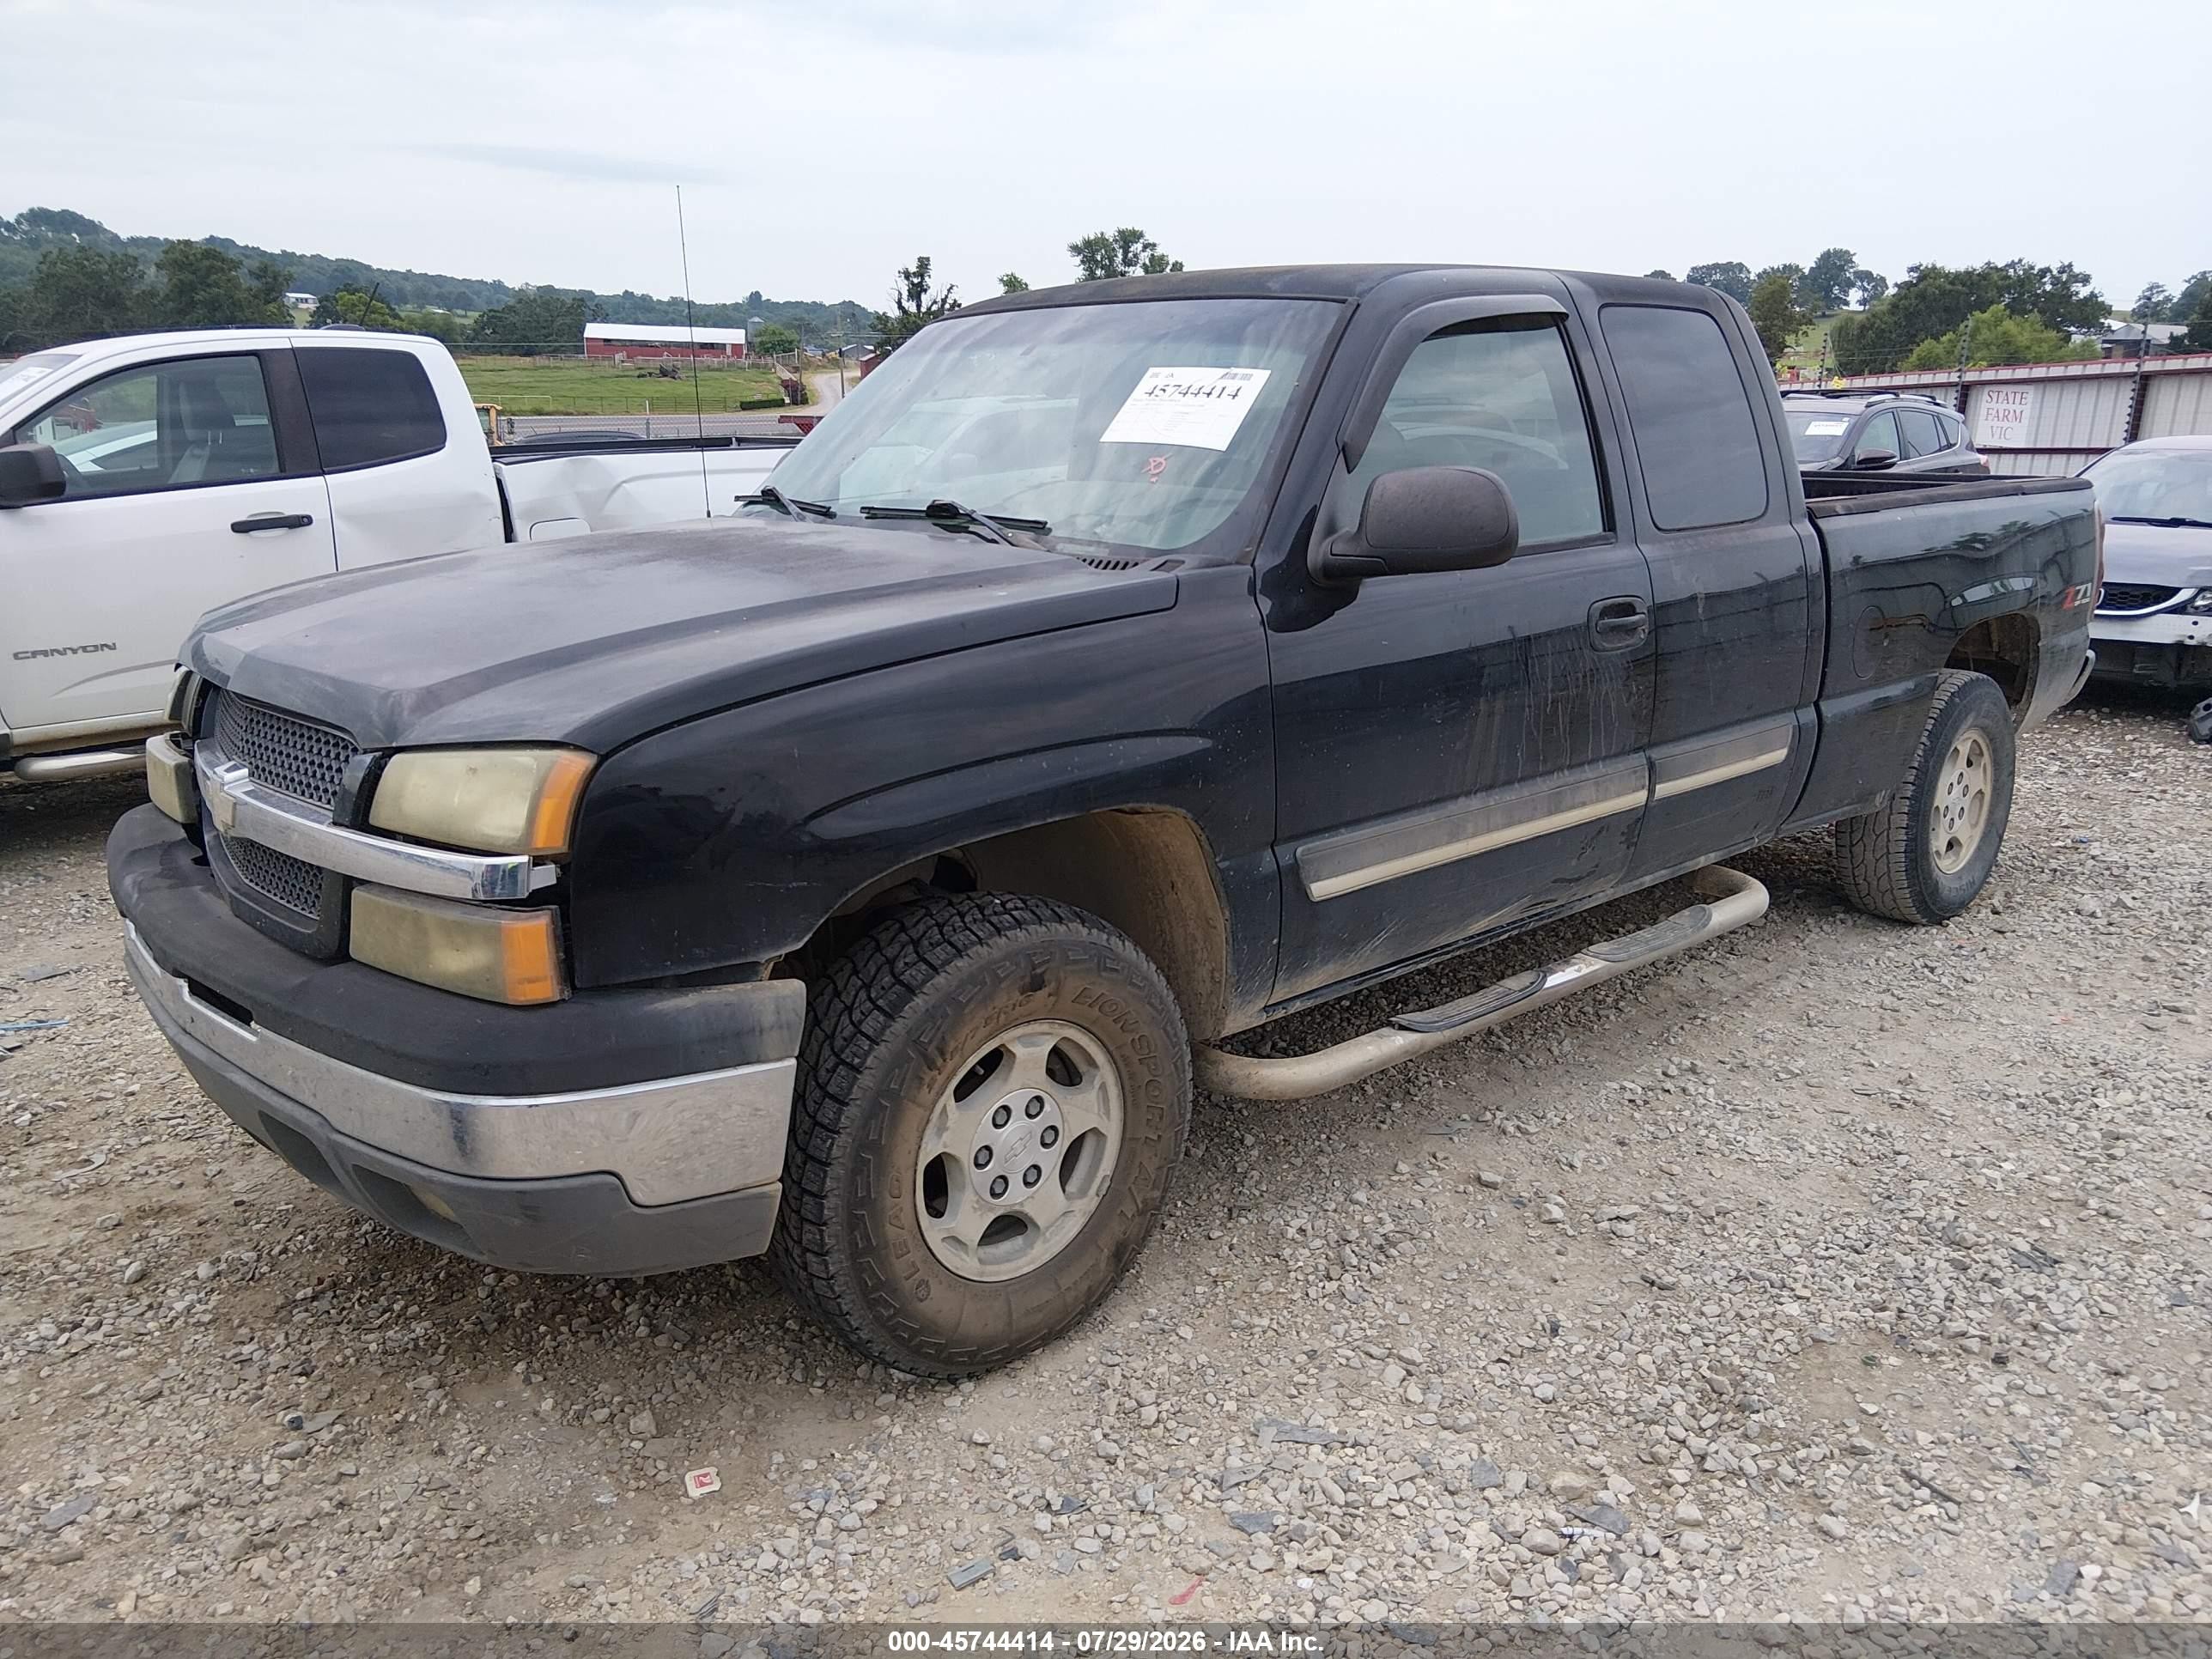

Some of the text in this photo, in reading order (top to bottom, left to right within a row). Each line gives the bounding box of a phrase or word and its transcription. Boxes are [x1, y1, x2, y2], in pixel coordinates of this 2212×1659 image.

[1145, 384, 1243, 400] 45744414
[1985, 389, 2029, 406] STATE
[1984, 407, 2025, 423] FARM
[1990, 425, 2014, 441] VIC
[2061, 582, 2093, 612] Z71
[13, 641, 118, 660] CANYON
